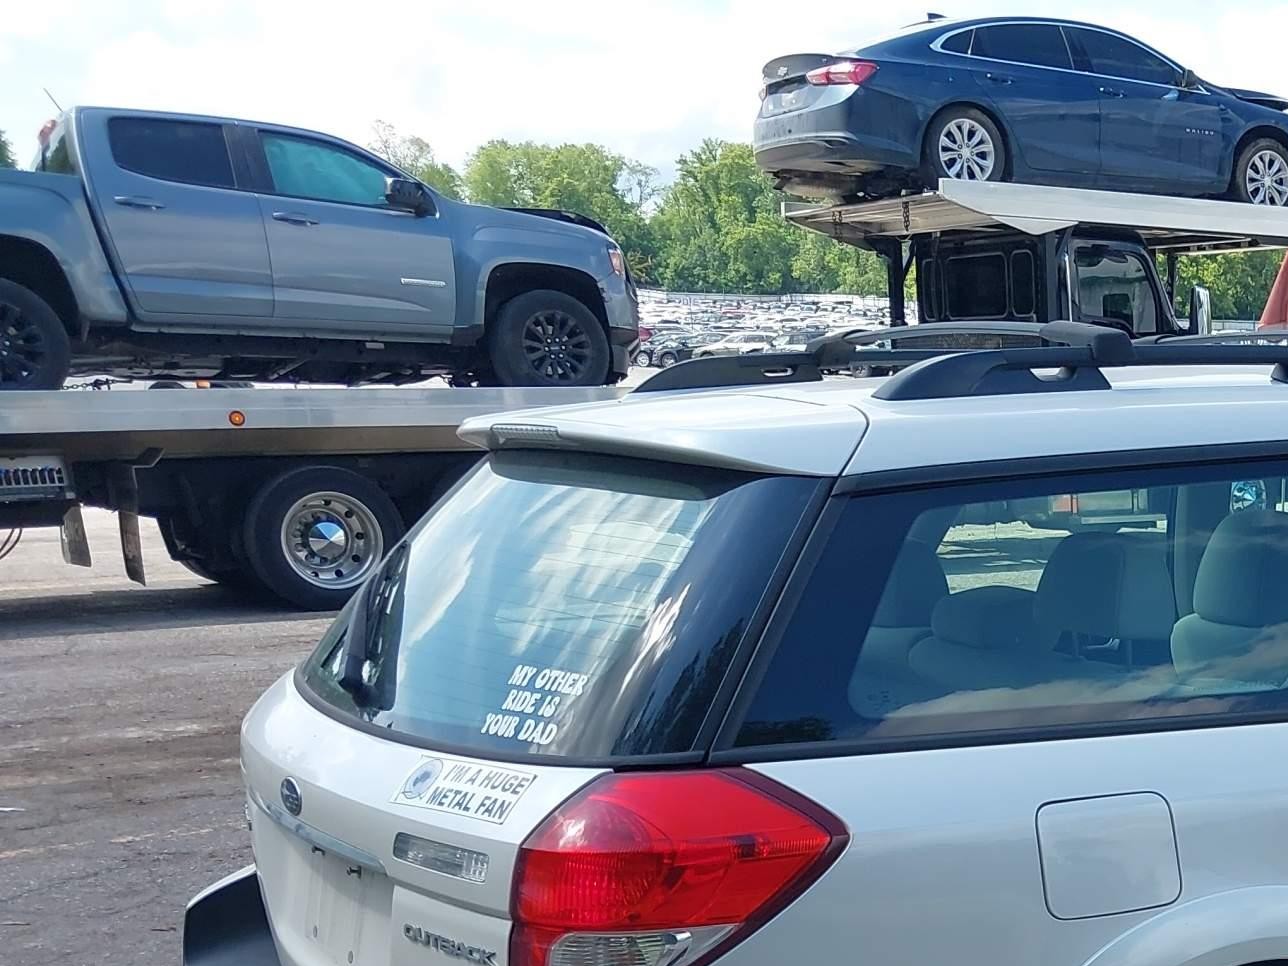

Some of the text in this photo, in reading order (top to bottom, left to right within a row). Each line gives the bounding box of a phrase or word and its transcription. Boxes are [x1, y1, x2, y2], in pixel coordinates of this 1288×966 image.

[507, 664, 588, 697] MY OTHER
[501, 689, 561, 718] RIDE IS
[480, 712, 558, 745] YOUR DAD
[442, 764, 531, 796] I'M A HUGE
[425, 786, 513, 820] METAL FAN
